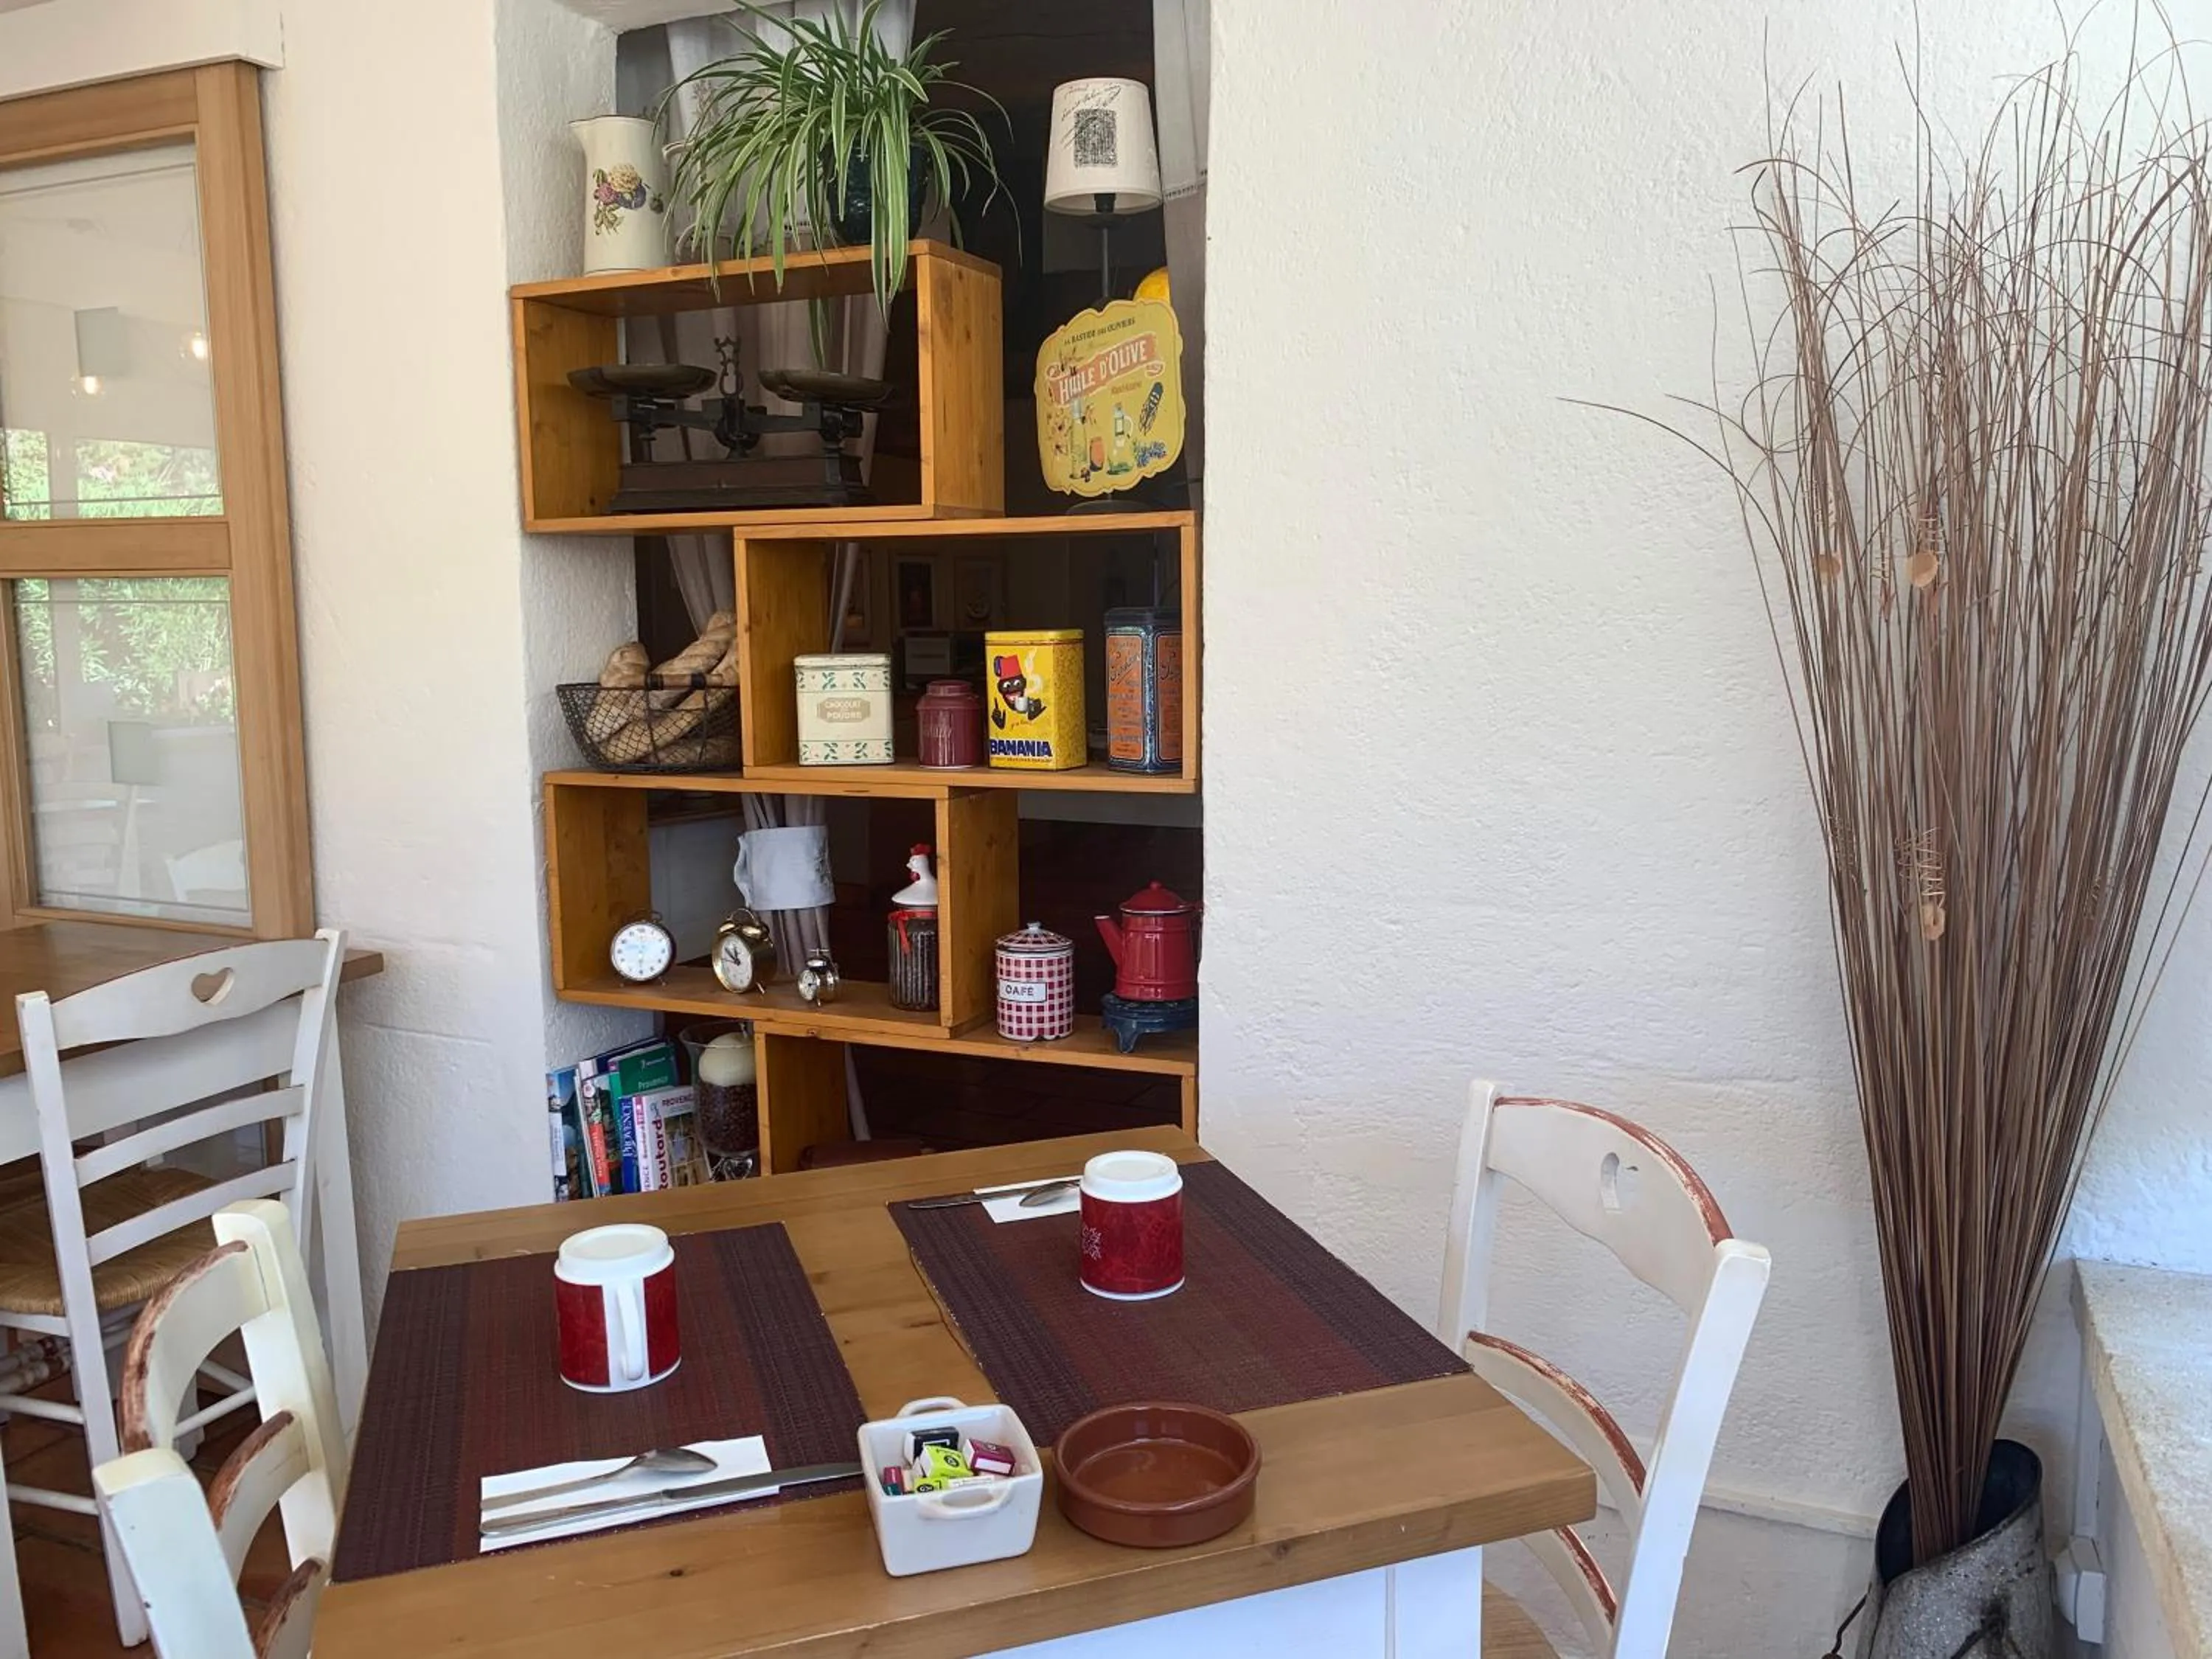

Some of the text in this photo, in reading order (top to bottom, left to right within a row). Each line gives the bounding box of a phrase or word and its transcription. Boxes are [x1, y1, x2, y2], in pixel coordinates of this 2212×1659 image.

[1059, 340, 1147, 405] HUILE D'OLIVE
[990, 740, 1053, 757] BANANIA
